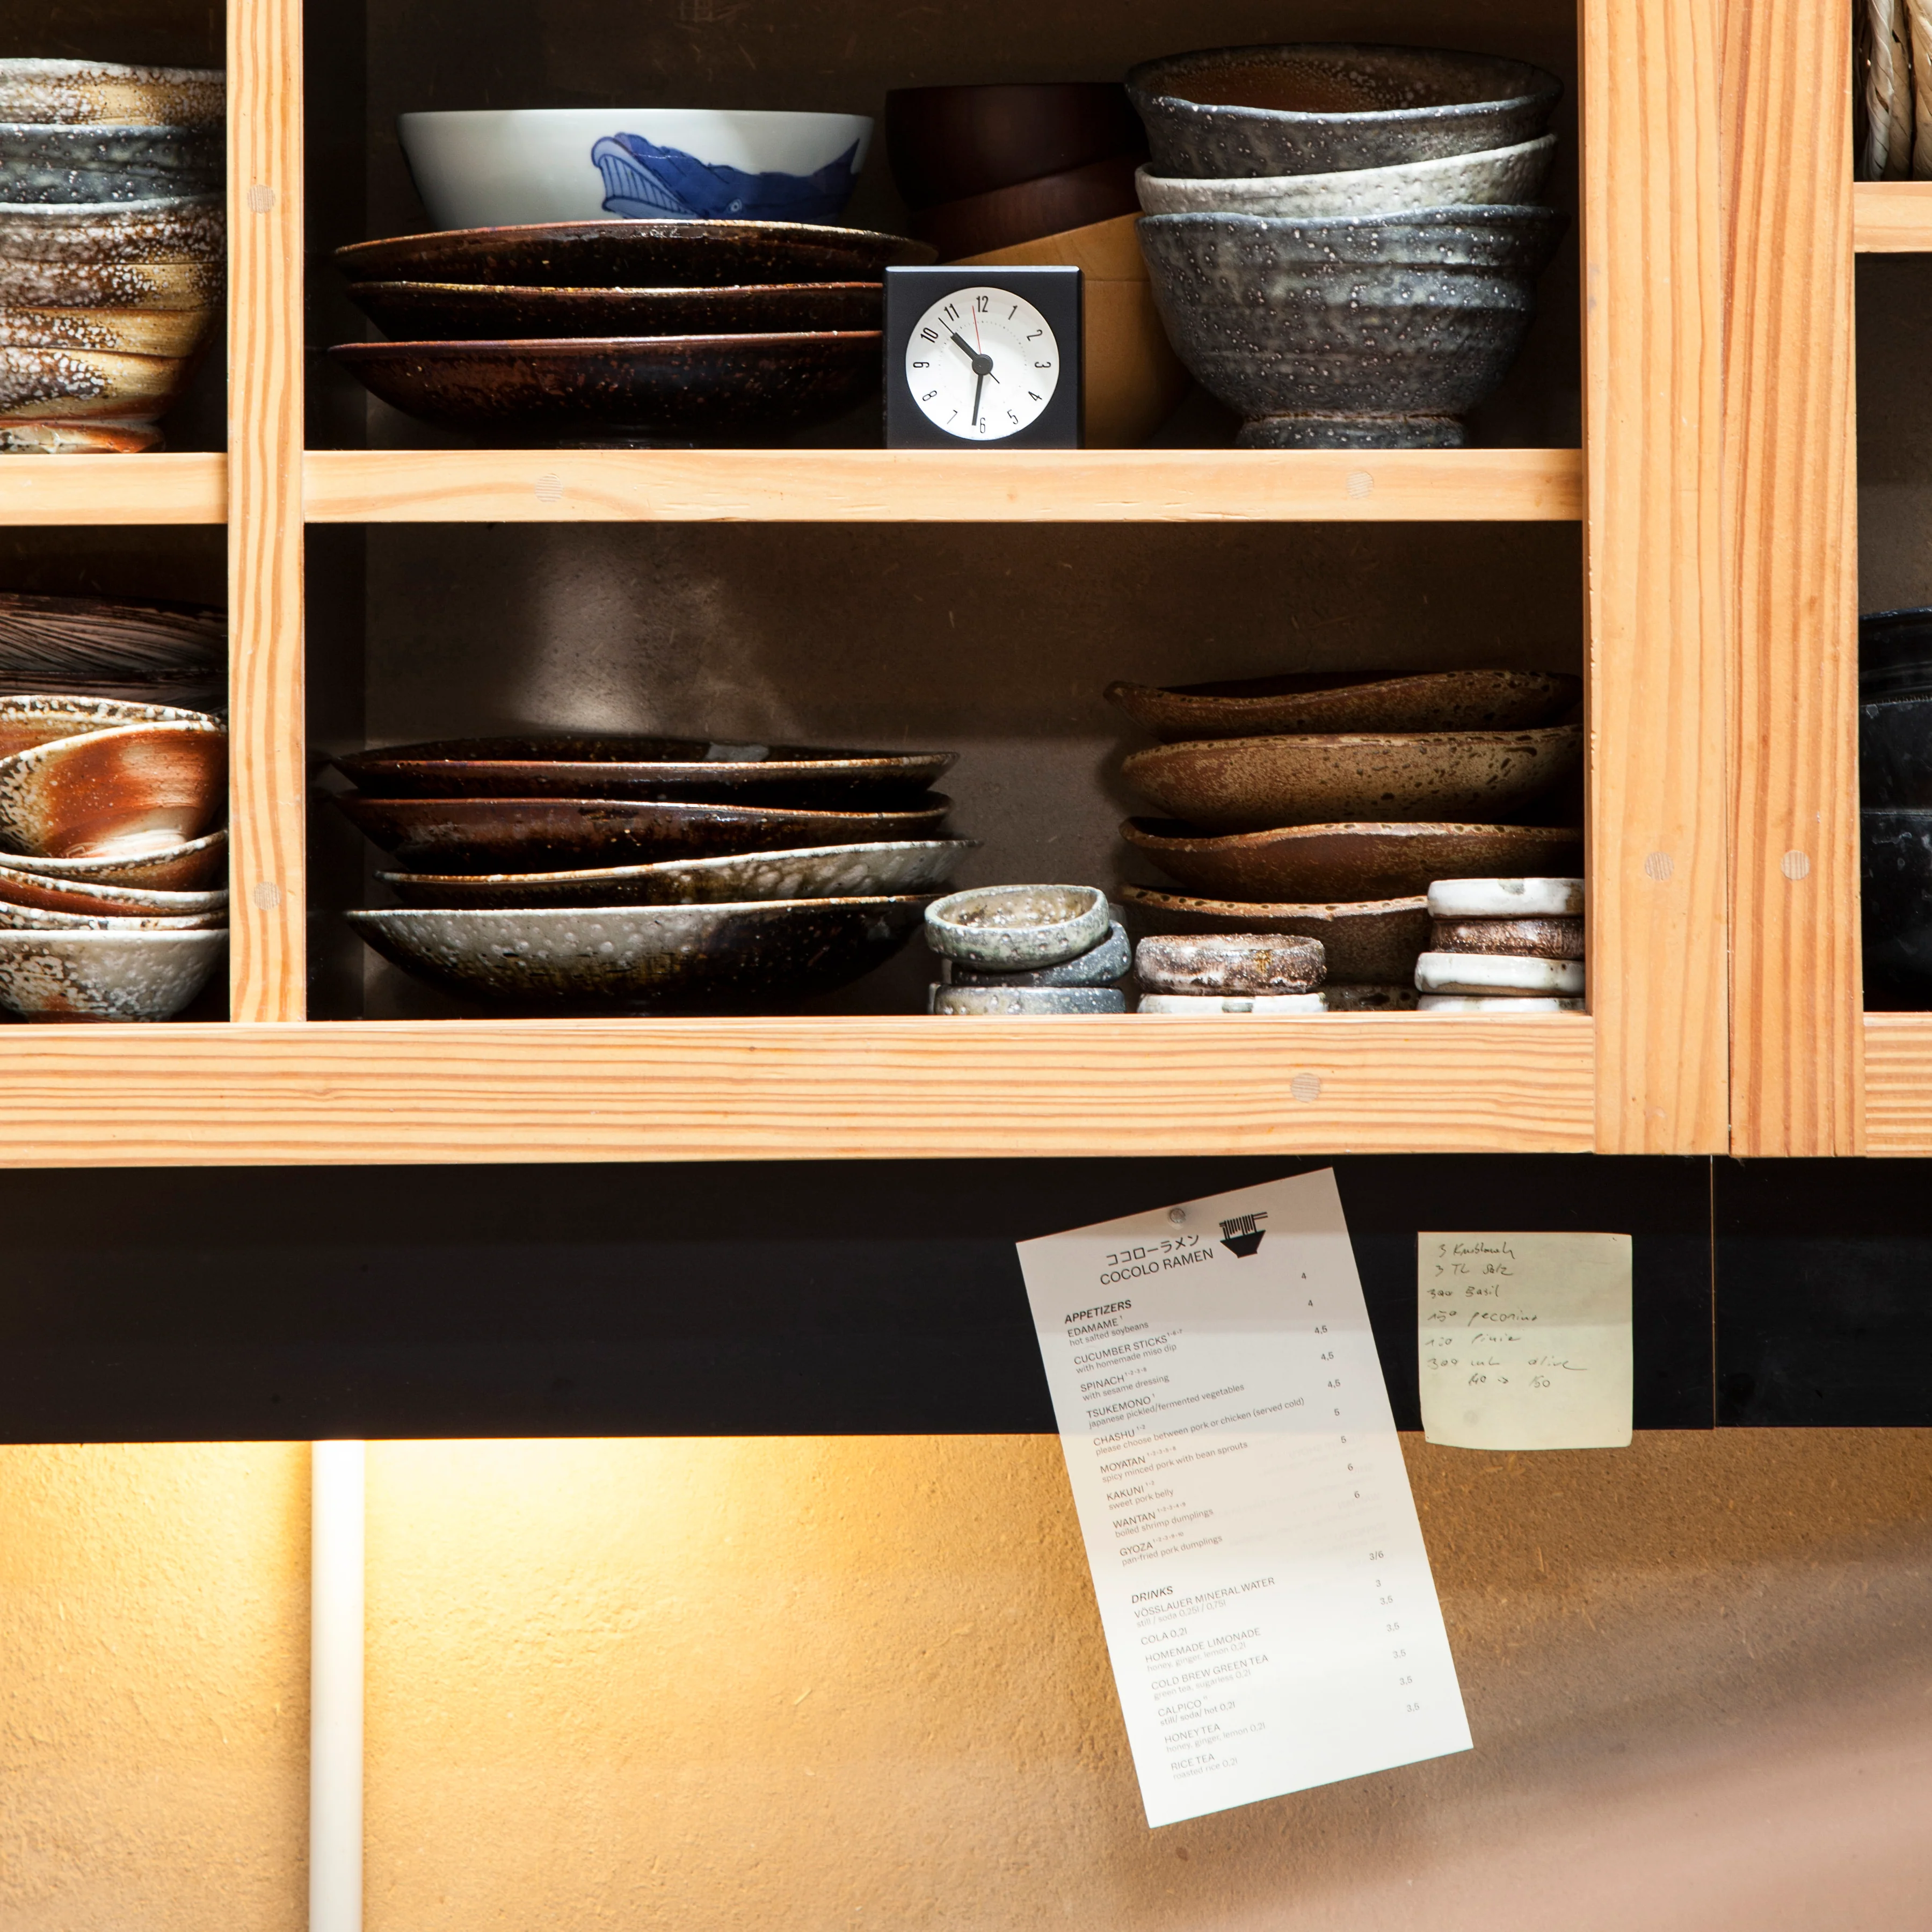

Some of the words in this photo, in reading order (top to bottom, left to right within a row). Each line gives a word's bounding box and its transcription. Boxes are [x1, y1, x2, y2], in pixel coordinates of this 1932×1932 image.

[943, 303, 960, 321] 11
[975, 295, 989, 313] 12
[1008, 305, 1018, 320] 1
[920, 327, 939, 343] 10
[1027, 329, 1043, 342] 2
[922, 390, 938, 401] 8
[1028, 391, 1042, 401] 4
[947, 409, 958, 424] 7
[979, 417, 986, 433] 6
[1007, 409, 1019, 425] 5
[1106, 1234, 1199, 1267] ココローラメン
[1439, 1244, 1447, 1258] 3
[1099, 1261, 1159, 1285] COCOLO
[1161, 1247, 1214, 1270] RAMEN
[1435, 1265, 1444, 1277] 3
[1483, 1263, 1515, 1276] Salz
[1301, 1272, 1307, 1280] 4
[1064, 1299, 1132, 1324] APPETIZERS
[1307, 1299, 1313, 1307] 4
[1066, 1317, 1118, 1338] EDAMAME
[1069, 1337, 1084, 1347] hot
[1084, 1329, 1110, 1343] salted
[1110, 1321, 1149, 1337] soybeans
[1313, 1324, 1328, 1334] 4,5
[1073, 1343, 1131, 1365] CUCUMBER
[1132, 1334, 1168, 1350] STICKS
[1320, 1350, 1334, 1361] 4,5
[1075, 1363, 1095, 1374] with
[1094, 1352, 1141, 1369] homemade
[1142, 1347, 1163, 1357] miso
[1163, 1343, 1177, 1353] dip
[1079, 1374, 1125, 1392] SPINACH
[1081, 1390, 1101, 1401] with
[1102, 1383, 1134, 1397] sesame
[1134, 1374, 1170, 1389] dressing
[1327, 1378, 1341, 1389] 4,5
[1086, 1396, 1151, 1419] TSUKEMONO
[1088, 1413, 1124, 1430] japanese
[1125, 1393, 1200, 1420] pickled/fermented
[1200, 1384, 1245, 1400] vegetables
[1333, 1407, 1340, 1417] 5
[1095, 1443, 1121, 1457] please
[1122, 1436, 1152, 1449] choose
[1152, 1427, 1189, 1441] between
[1189, 1421, 1210, 1434] pork
[1209, 1419, 1219, 1427] or
[1219, 1411, 1252, 1425] chicken
[1252, 1402, 1283, 1418] (served
[1283, 1396, 1305, 1409] cold)
[1093, 1428, 1135, 1446] CHASHU
[1340, 1435, 1347, 1444] 5
[1099, 1455, 1146, 1474] MOYATAN
[1101, 1472, 1123, 1484] spicy
[1123, 1462, 1154, 1477] minced
[1155, 1458, 1175, 1471] pork
[1174, 1454, 1194, 1465] with
[1194, 1449, 1216, 1460] bean
[1216, 1441, 1248, 1455] sprouts
[1347, 1462, 1354, 1471] 6
[1106, 1484, 1144, 1501] KAKUNI
[1108, 1497, 1134, 1510] sweet
[1134, 1493, 1154, 1506] pork
[1154, 1488, 1174, 1499] belly
[1353, 1490, 1360, 1499] 6
[1112, 1511, 1156, 1529] WANTAN
[1114, 1524, 1140, 1538] boiled
[1141, 1519, 1170, 1532] shrimp
[1171, 1508, 1214, 1524] dumplings
[1118, 1541, 1153, 1557] GYOZA
[1121, 1549, 1159, 1567] pan-fried
[1159, 1544, 1180, 1558] pork
[1180, 1535, 1223, 1551] dumplings
[1369, 1550, 1384, 1561] 3/6
[1375, 1579, 1382, 1588] 3
[1131, 1585, 1173, 1604] DRINKS
[1133, 1597, 1193, 1618] VÖSSLAUER
[1194, 1586, 1240, 1603] MINERAL
[1240, 1576, 1275, 1592] WATER
[1379, 1594, 1393, 1606] 3,5
[1136, 1616, 1151, 1628] still
[1157, 1612, 1178, 1623] soda
[1385, 1621, 1400, 1632] 3,5
[1140, 1631, 1169, 1645] COLA
[1144, 1641, 1204, 1663] HOMEMADE
[1206, 1627, 1261, 1648] LIMONADE
[1202, 1646, 1229, 1658] lemon
[1392, 1648, 1406, 1659] 3,5
[1150, 1676, 1179, 1690] COLD
[1181, 1668, 1210, 1683] BREW
[1212, 1659, 1248, 1675] GREEN
[1248, 1654, 1269, 1665] TEA
[1398, 1675, 1413, 1686] 3,5
[1153, 1688, 1177, 1701] green
[1195, 1673, 1234, 1689] sugarless
[1157, 1698, 1202, 1717] CALPICO
[1159, 1713, 1178, 1726] still/
[1179, 1708, 1202, 1722] soda/
[1203, 1705, 1218, 1715] hot
[1406, 1702, 1420, 1712] 3,5
[1164, 1727, 1199, 1744] HONEY
[1200, 1723, 1221, 1734] TEA
[1222, 1727, 1248, 1739] lemon
[1170, 1757, 1194, 1771] RICE
[1195, 1753, 1215, 1764] TEA
[1172, 1765, 1203, 1780] roasted
[1204, 1763, 1221, 1772] rice
